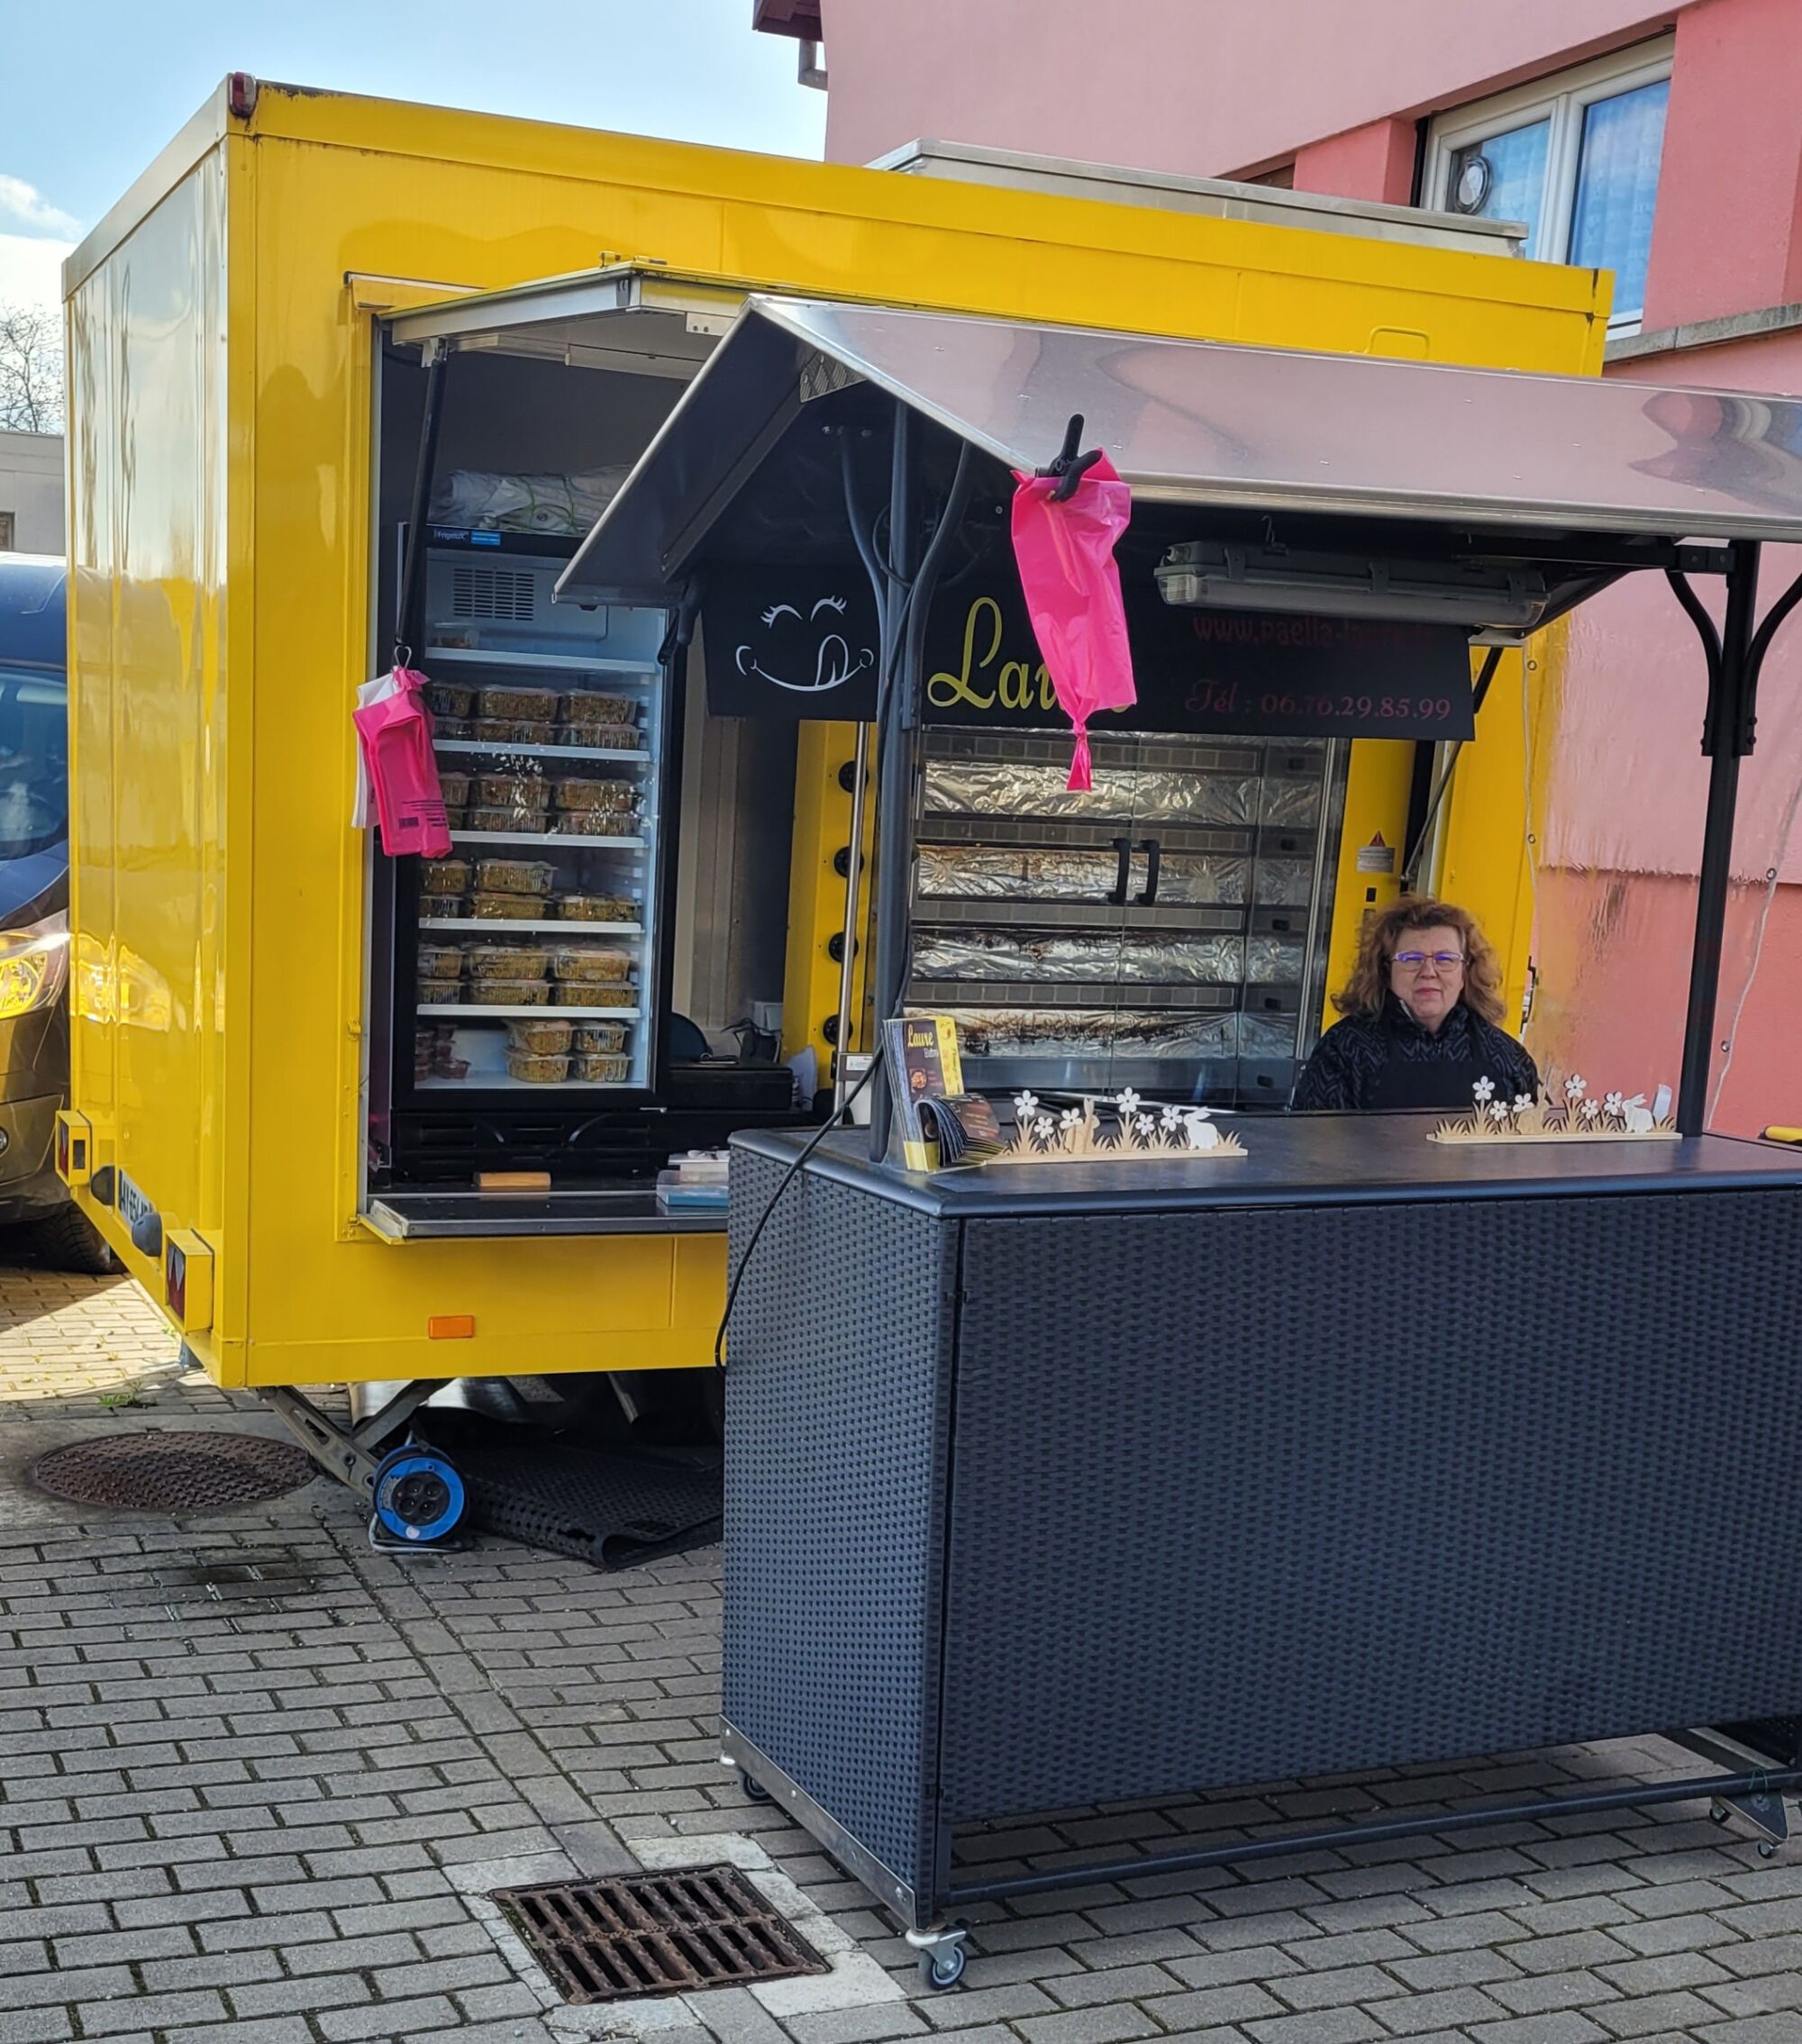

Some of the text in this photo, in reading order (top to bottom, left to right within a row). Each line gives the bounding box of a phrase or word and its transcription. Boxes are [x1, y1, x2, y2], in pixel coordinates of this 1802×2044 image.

[1184, 677, 1239, 713] Tél
[1260, 693, 1452, 721] 06.76.29.85.99
[907, 1023, 934, 1048] Laure
